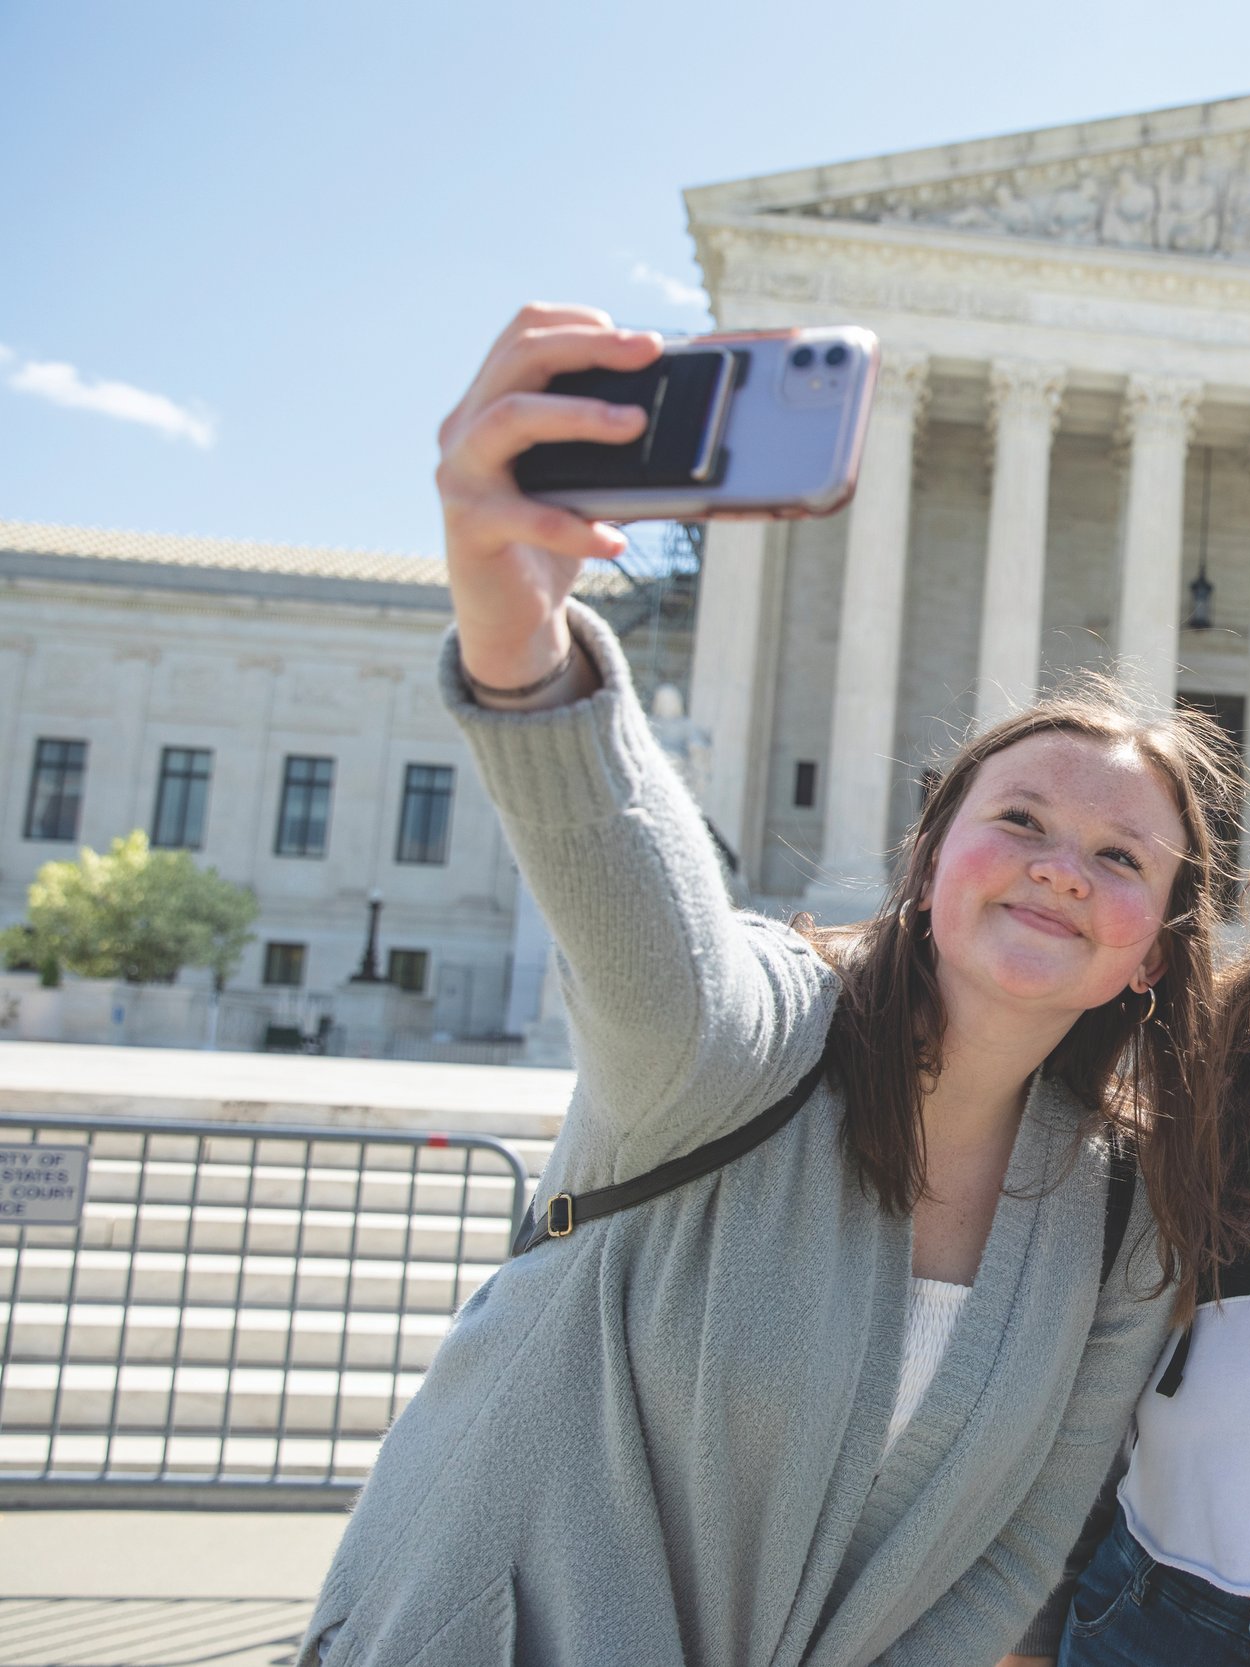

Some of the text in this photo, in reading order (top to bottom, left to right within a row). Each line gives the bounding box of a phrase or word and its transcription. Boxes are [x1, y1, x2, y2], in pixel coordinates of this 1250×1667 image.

[38, 1152, 64, 1168] OF
[2, 1168, 69, 1184] STATES
[10, 1184, 74, 1201] COURT
